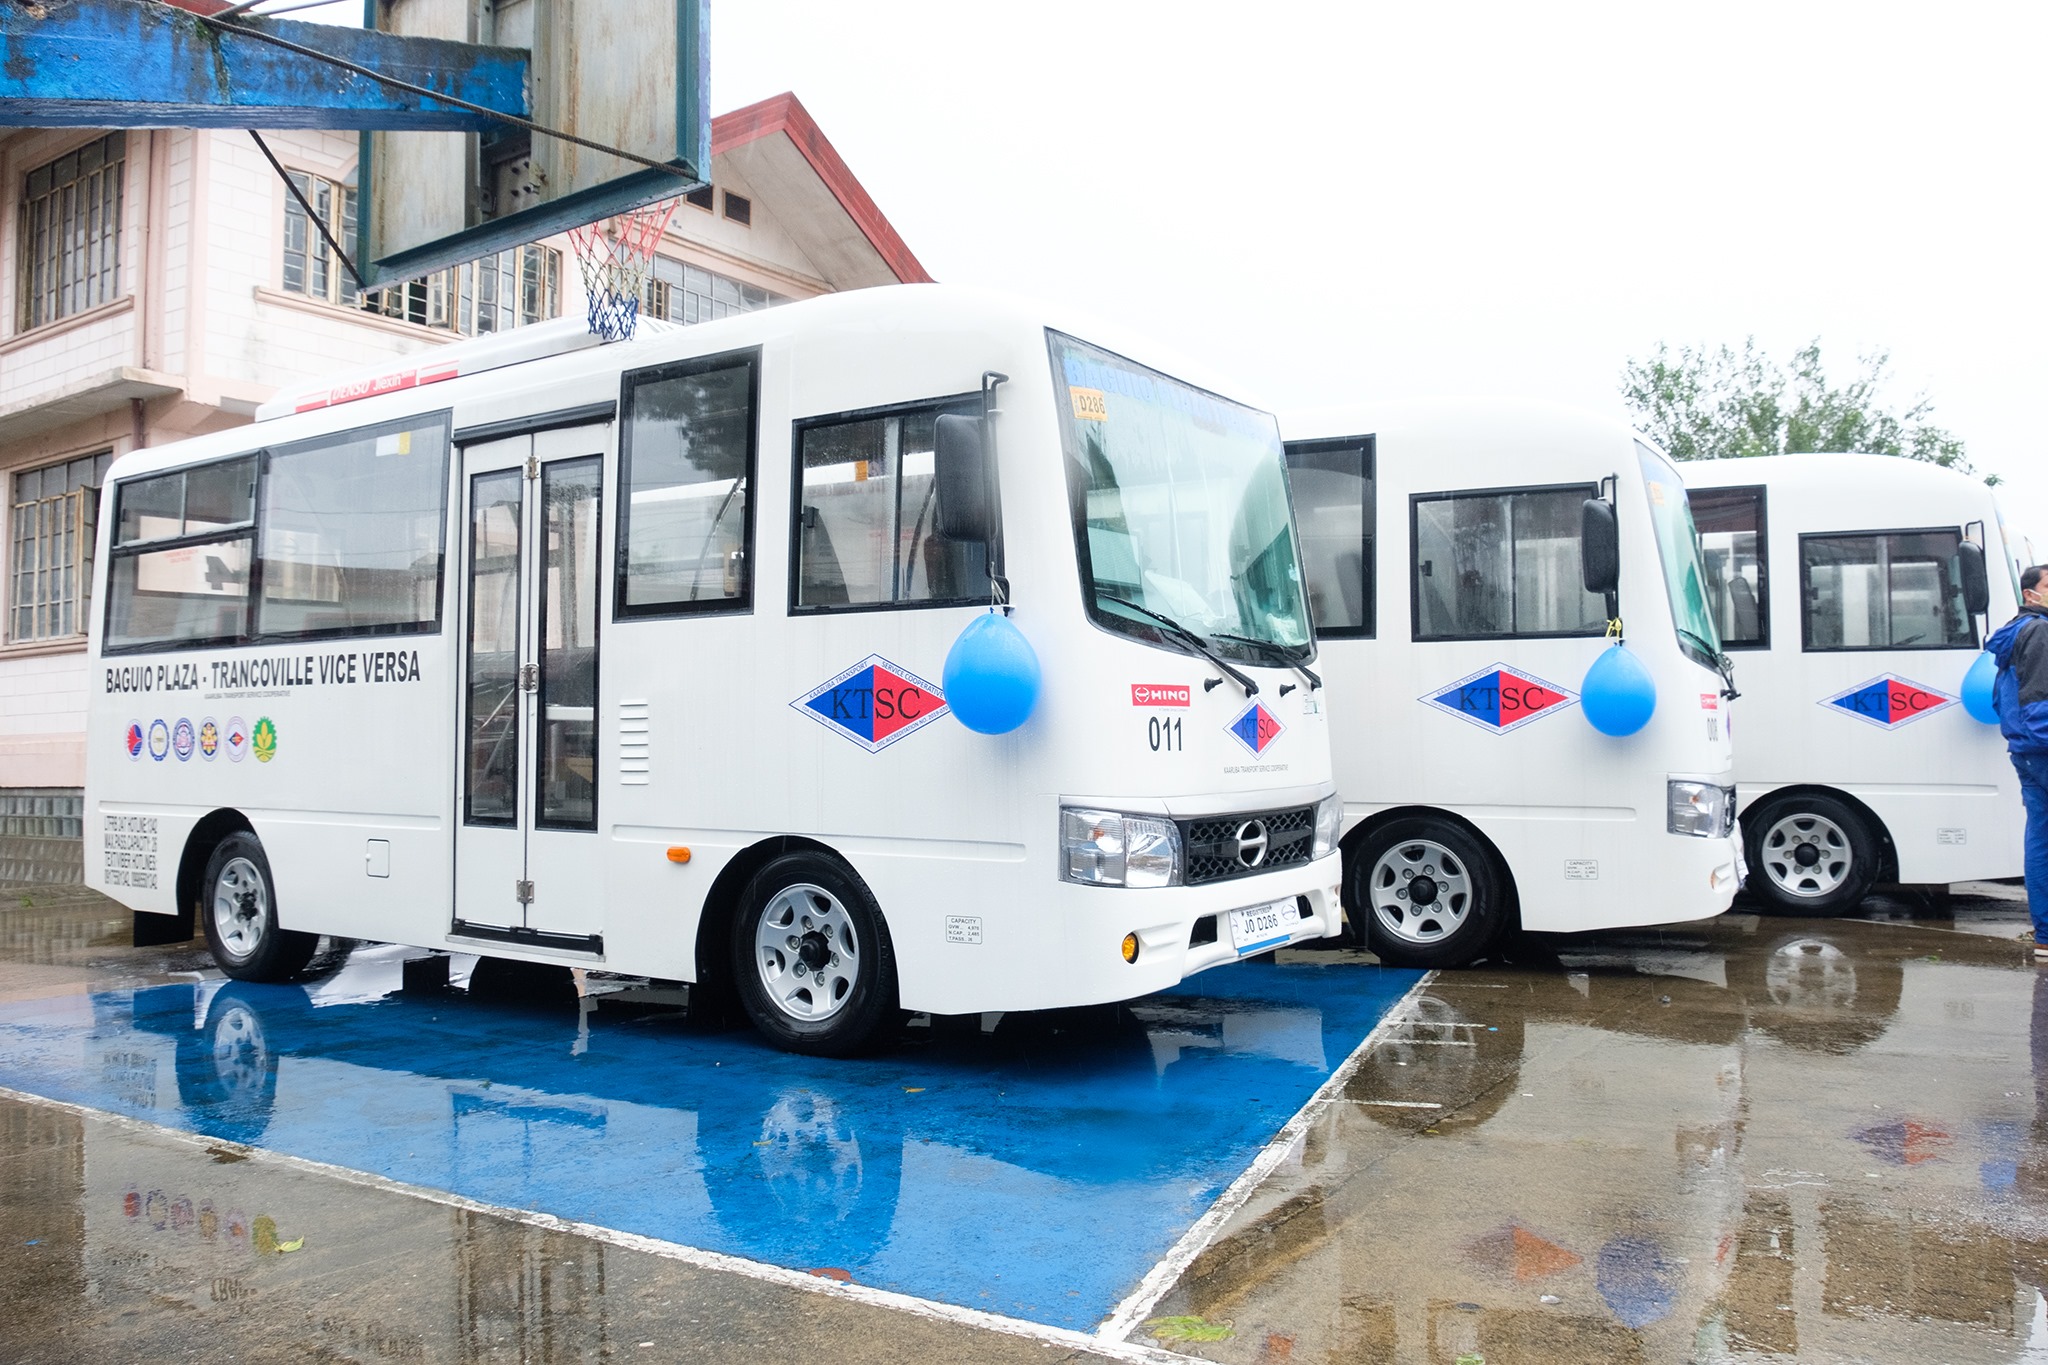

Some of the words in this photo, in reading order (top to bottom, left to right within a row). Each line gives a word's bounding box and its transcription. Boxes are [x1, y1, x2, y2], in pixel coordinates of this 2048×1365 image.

[332, 380, 371, 400] DENSO
[1079, 395, 1106, 415] D286
[106, 665, 153, 694] BAGUIO
[157, 663, 199, 691] PLAZA
[211, 656, 314, 690] TRANCOVILLE
[319, 653, 357, 685] VICE
[363, 650, 421, 683] VERSA
[808, 681, 836, 700] KAARUBA
[835, 660, 868, 684] TRANSPORT
[881, 661, 904, 678] SERVICE
[904, 672, 945, 699] COOPERATIVE
[830, 687, 921, 720] KTSC
[1150, 690, 1188, 702] HINO
[1458, 687, 1545, 711] KTSC
[1853, 691, 1929, 712] KTSC
[885, 722, 919, 743] ACCREDITATION
[1148, 716, 1182, 752] 011
[1241, 718, 1275, 739] KTSC
[1256, 913, 1279, 931] D286
